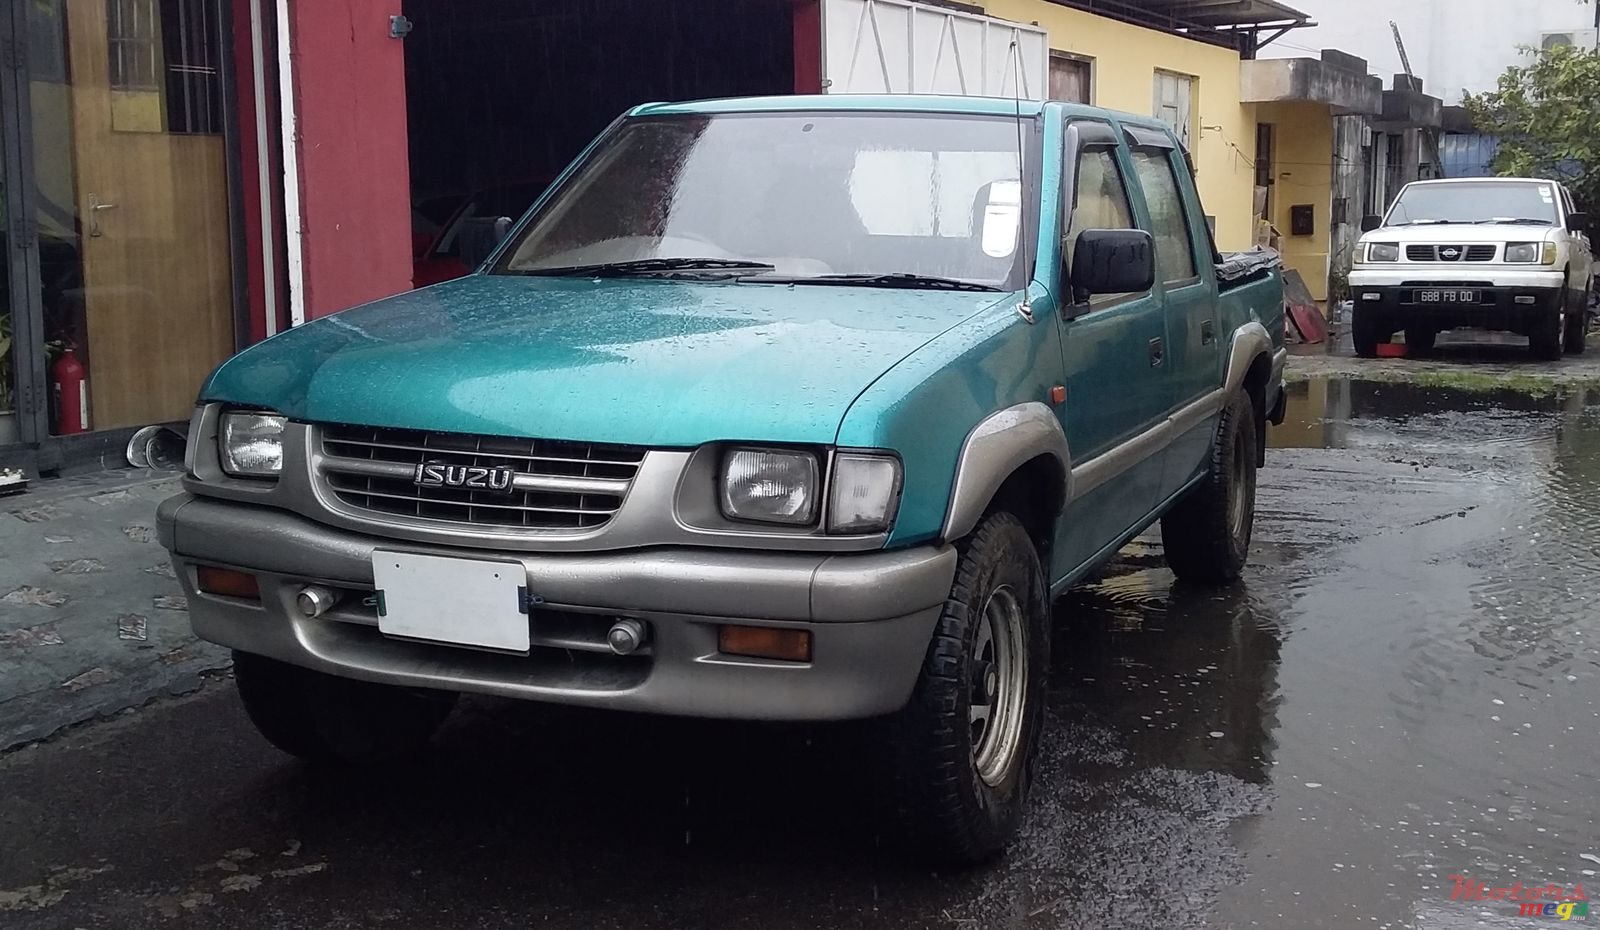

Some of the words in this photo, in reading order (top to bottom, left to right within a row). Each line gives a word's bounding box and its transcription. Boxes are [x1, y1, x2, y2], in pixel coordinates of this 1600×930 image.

[1421, 291, 1439, 301] 688
[1460, 291, 1472, 301] 00
[415, 463, 510, 489] ISUZU
